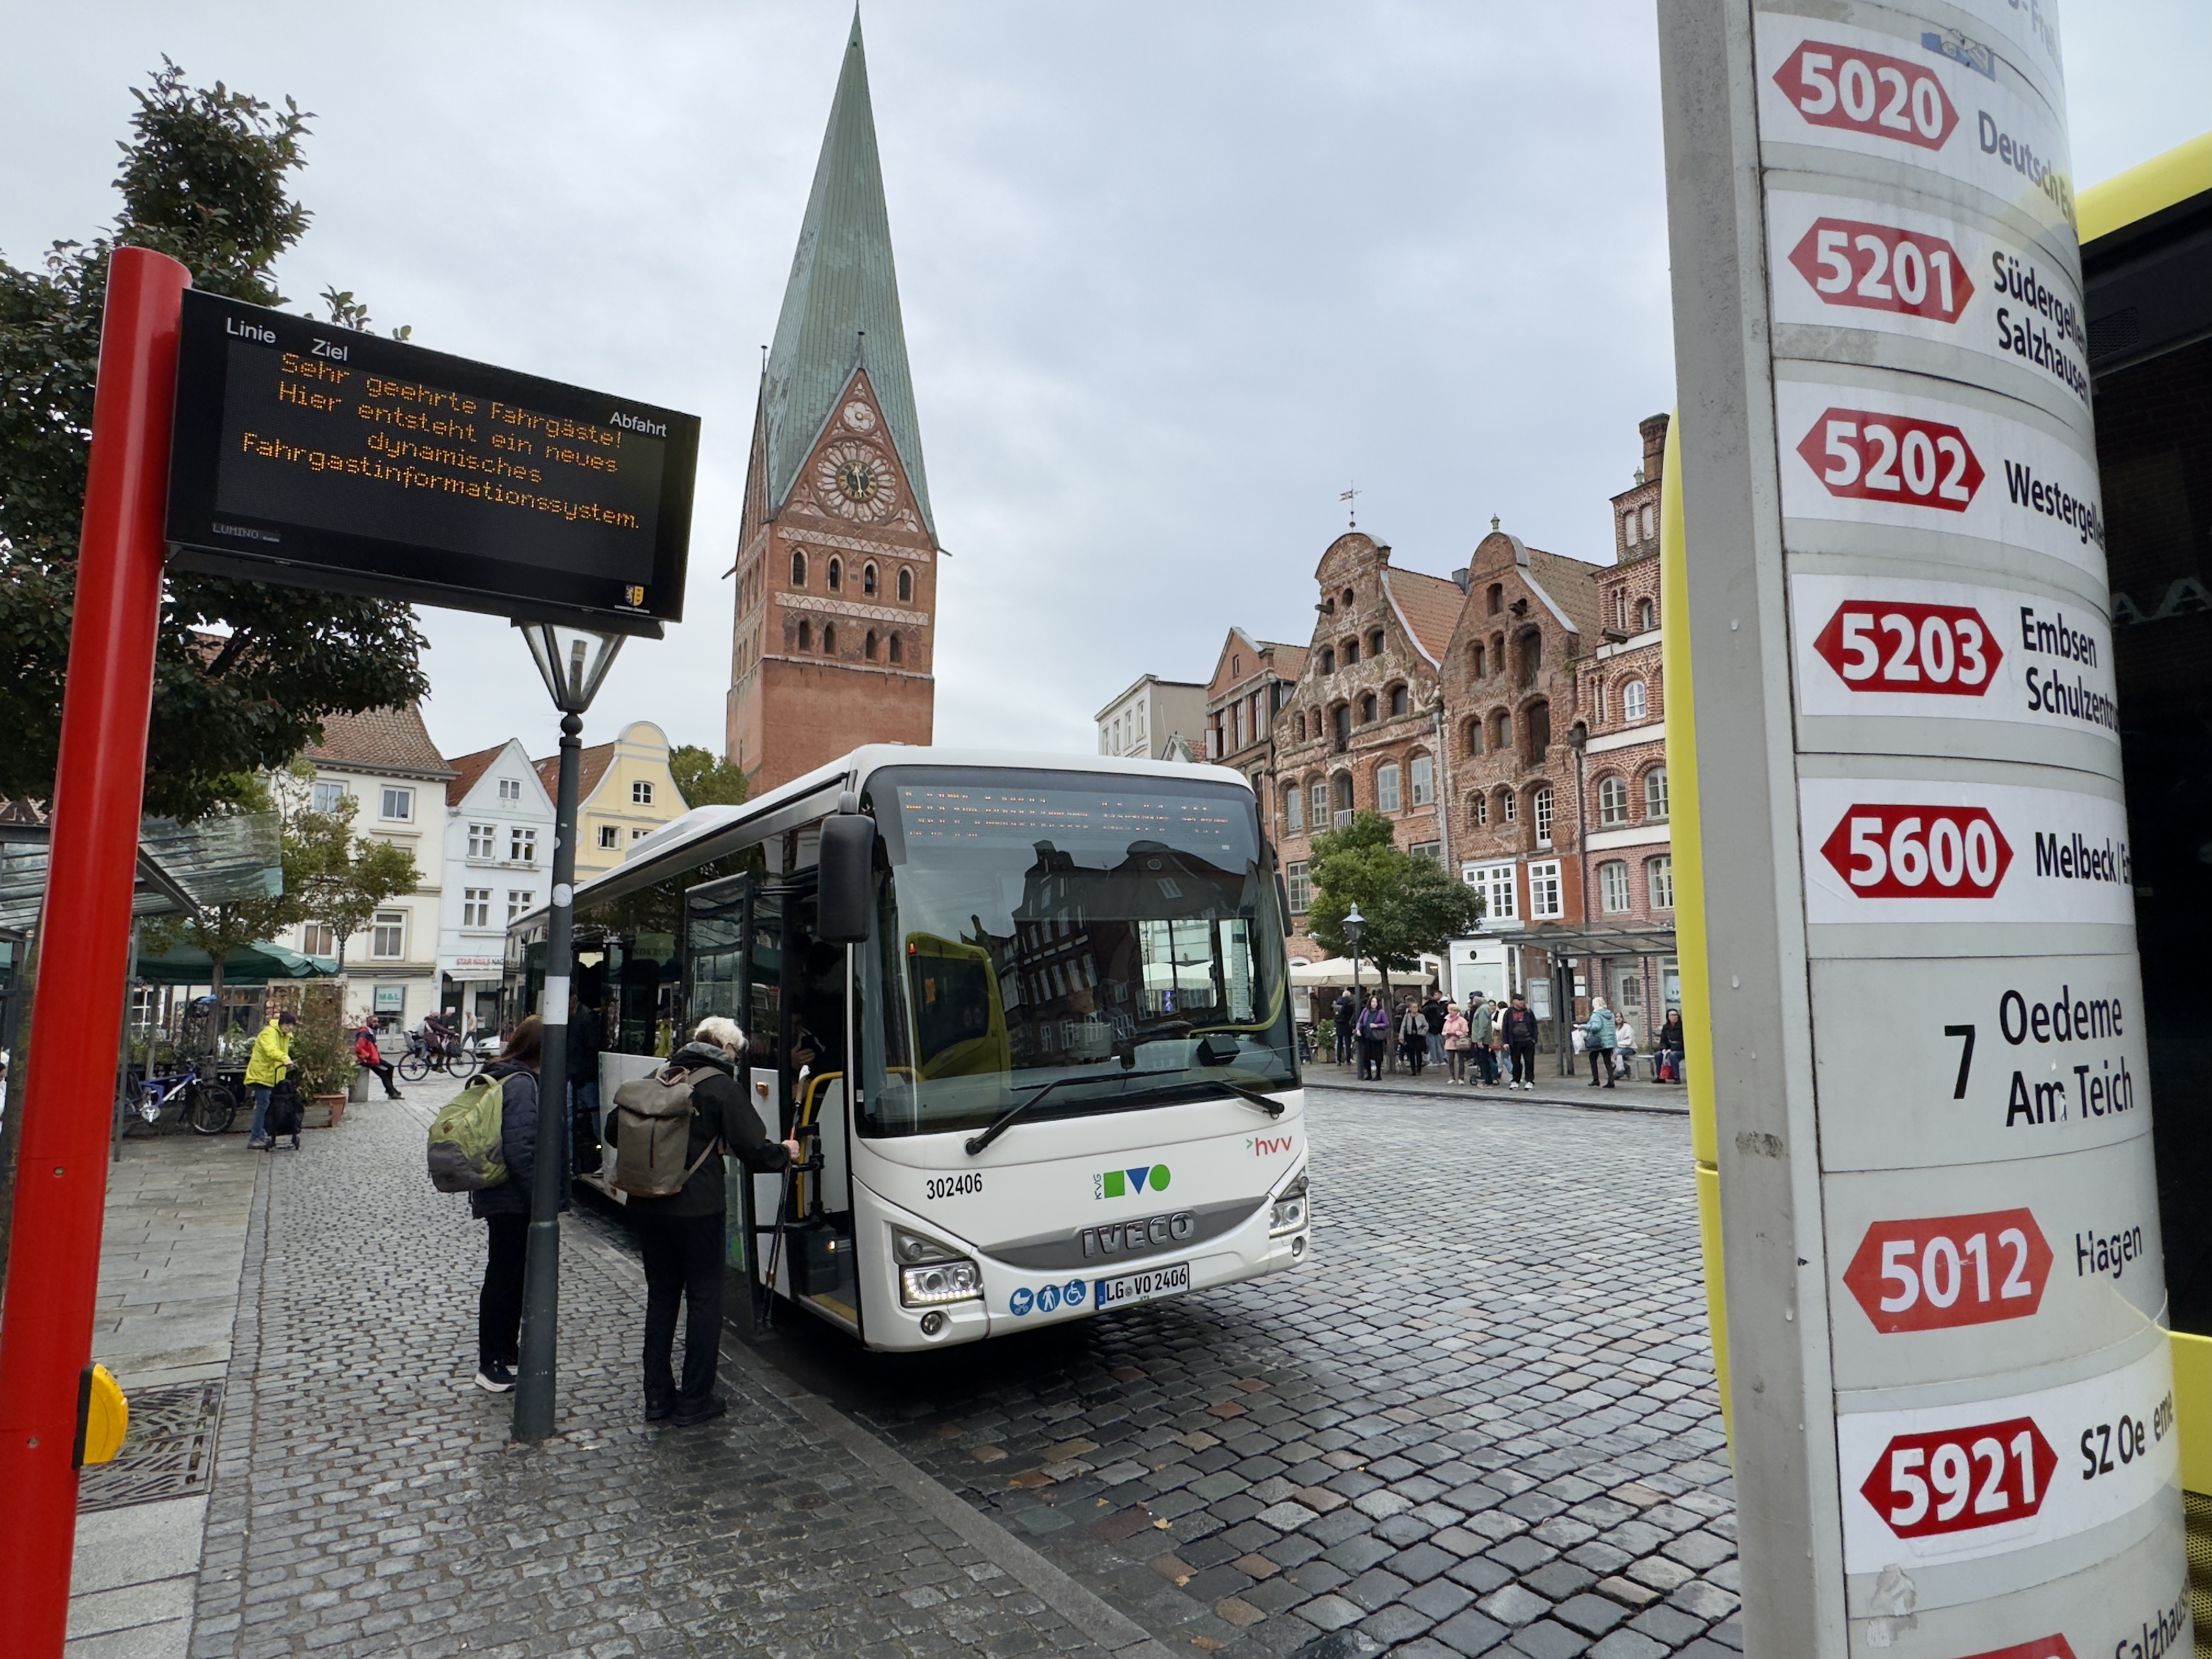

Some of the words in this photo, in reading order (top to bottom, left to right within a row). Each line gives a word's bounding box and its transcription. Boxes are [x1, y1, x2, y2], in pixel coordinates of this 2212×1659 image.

[1801, 52, 1943, 140] 5020
[1978, 110, 2059, 206] Deutsch
[1815, 228, 1954, 313] 5201
[226, 317, 276, 343] Linie
[311, 338, 348, 362] Ziel
[278, 381, 342, 411] Hier
[358, 404, 477, 443] entsteht
[492, 433, 532, 455] ein
[545, 444, 618, 473] neues
[281, 352, 351, 383] Sehr
[365, 377, 477, 415] geehrte
[490, 401, 622, 448] Fahrgäste!
[609, 411, 667, 437] Abfahrt
[242, 431, 640, 529] Fahrgastinformationssystem.
[366, 431, 543, 483] dynamisches
[1824, 419, 1970, 501] 5202
[1843, 613, 1987, 685] 5203
[2021, 606, 2097, 669] Embsen
[1850, 817, 1997, 887] 5600
[2035, 832, 2117, 883] Melbeck
[2000, 985, 2123, 1046] Oedeme
[1944, 1024, 1976, 1099] 7
[2006, 1070, 2068, 1127] Am
[2073, 1056, 2134, 1119] Teich
[1255, 1136, 1293, 1156] hvv
[927, 1173, 983, 1200] 302406
[1093, 1173, 1103, 1200] KVG
[1082, 1212, 1195, 1259] IVECO
[1880, 1228, 2032, 1312] 5012
[2075, 1225, 2143, 1279] Hagen
[1106, 1280, 1125, 1301] LG
[1135, 1275, 1151, 1295] VO
[1154, 1267, 1187, 1291] 2406
[1891, 1431, 2035, 1526] 5921
[2080, 1423, 2115, 1481] SZ
